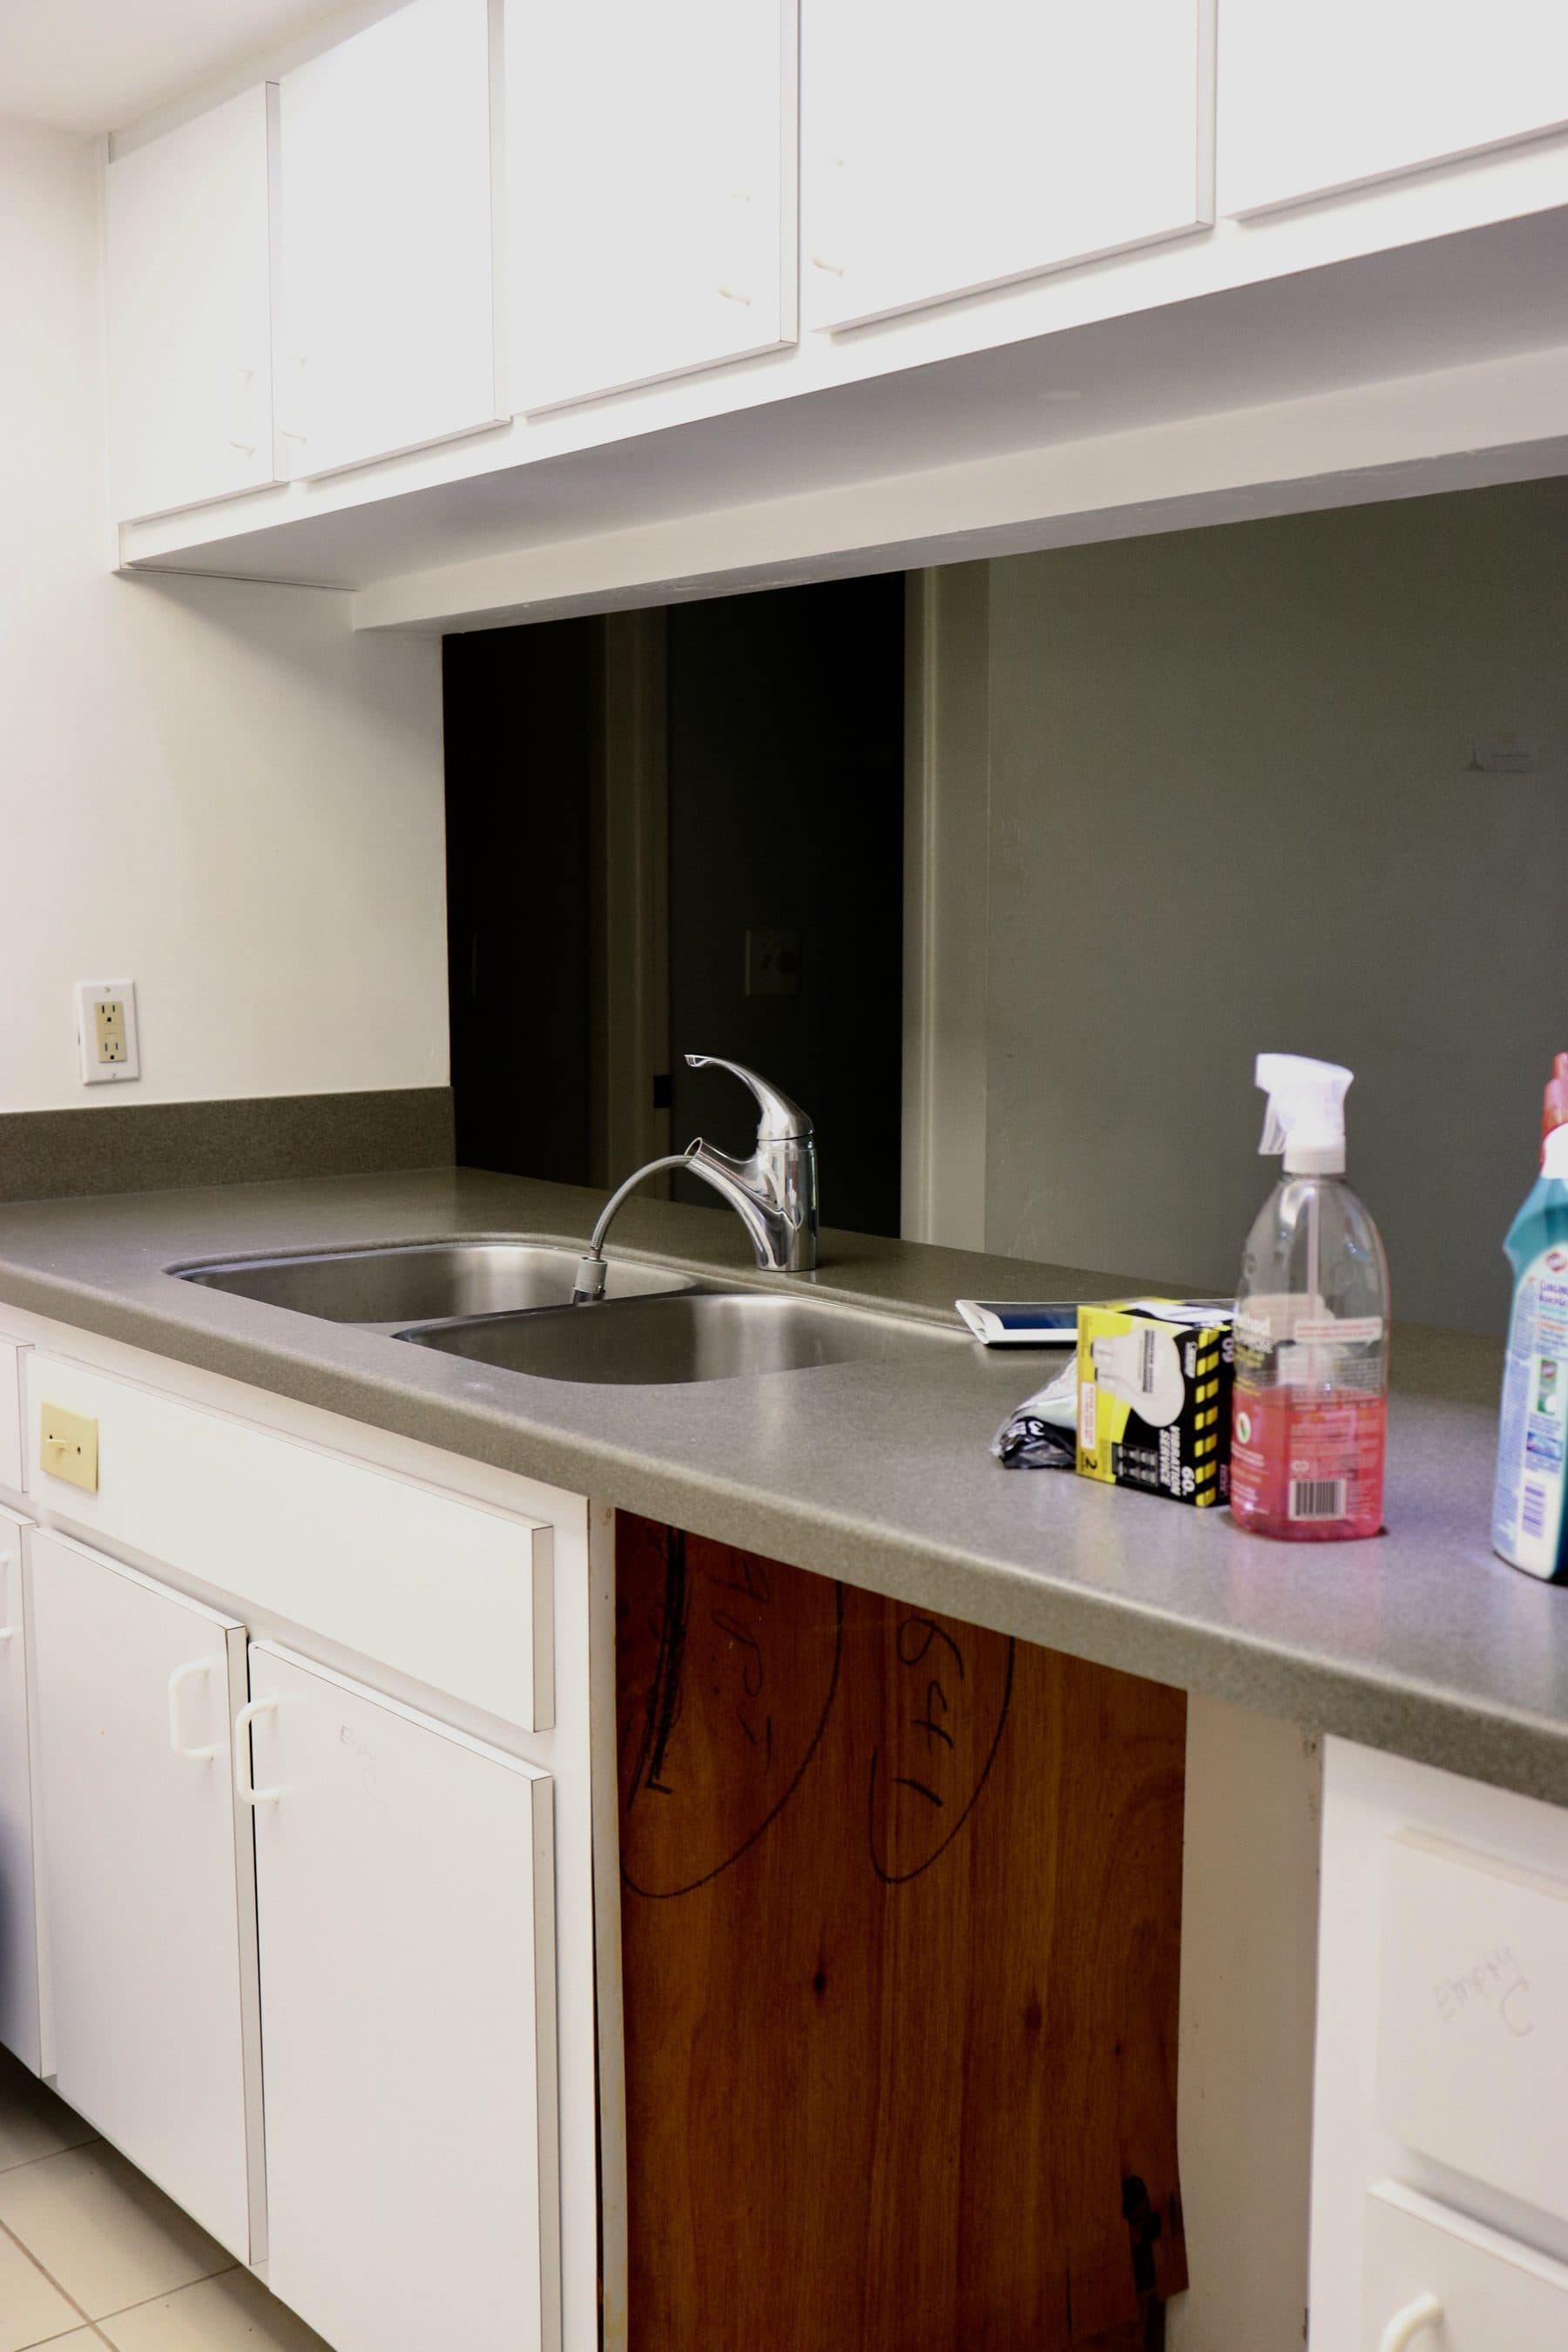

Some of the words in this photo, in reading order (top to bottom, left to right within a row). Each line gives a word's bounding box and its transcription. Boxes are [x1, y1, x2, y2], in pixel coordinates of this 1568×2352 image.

[1085, 1456, 1098, 1470] 2
[1159, 1428, 1171, 1487] SERVICE
[1169, 1424, 1181, 1497] VIBRATION
